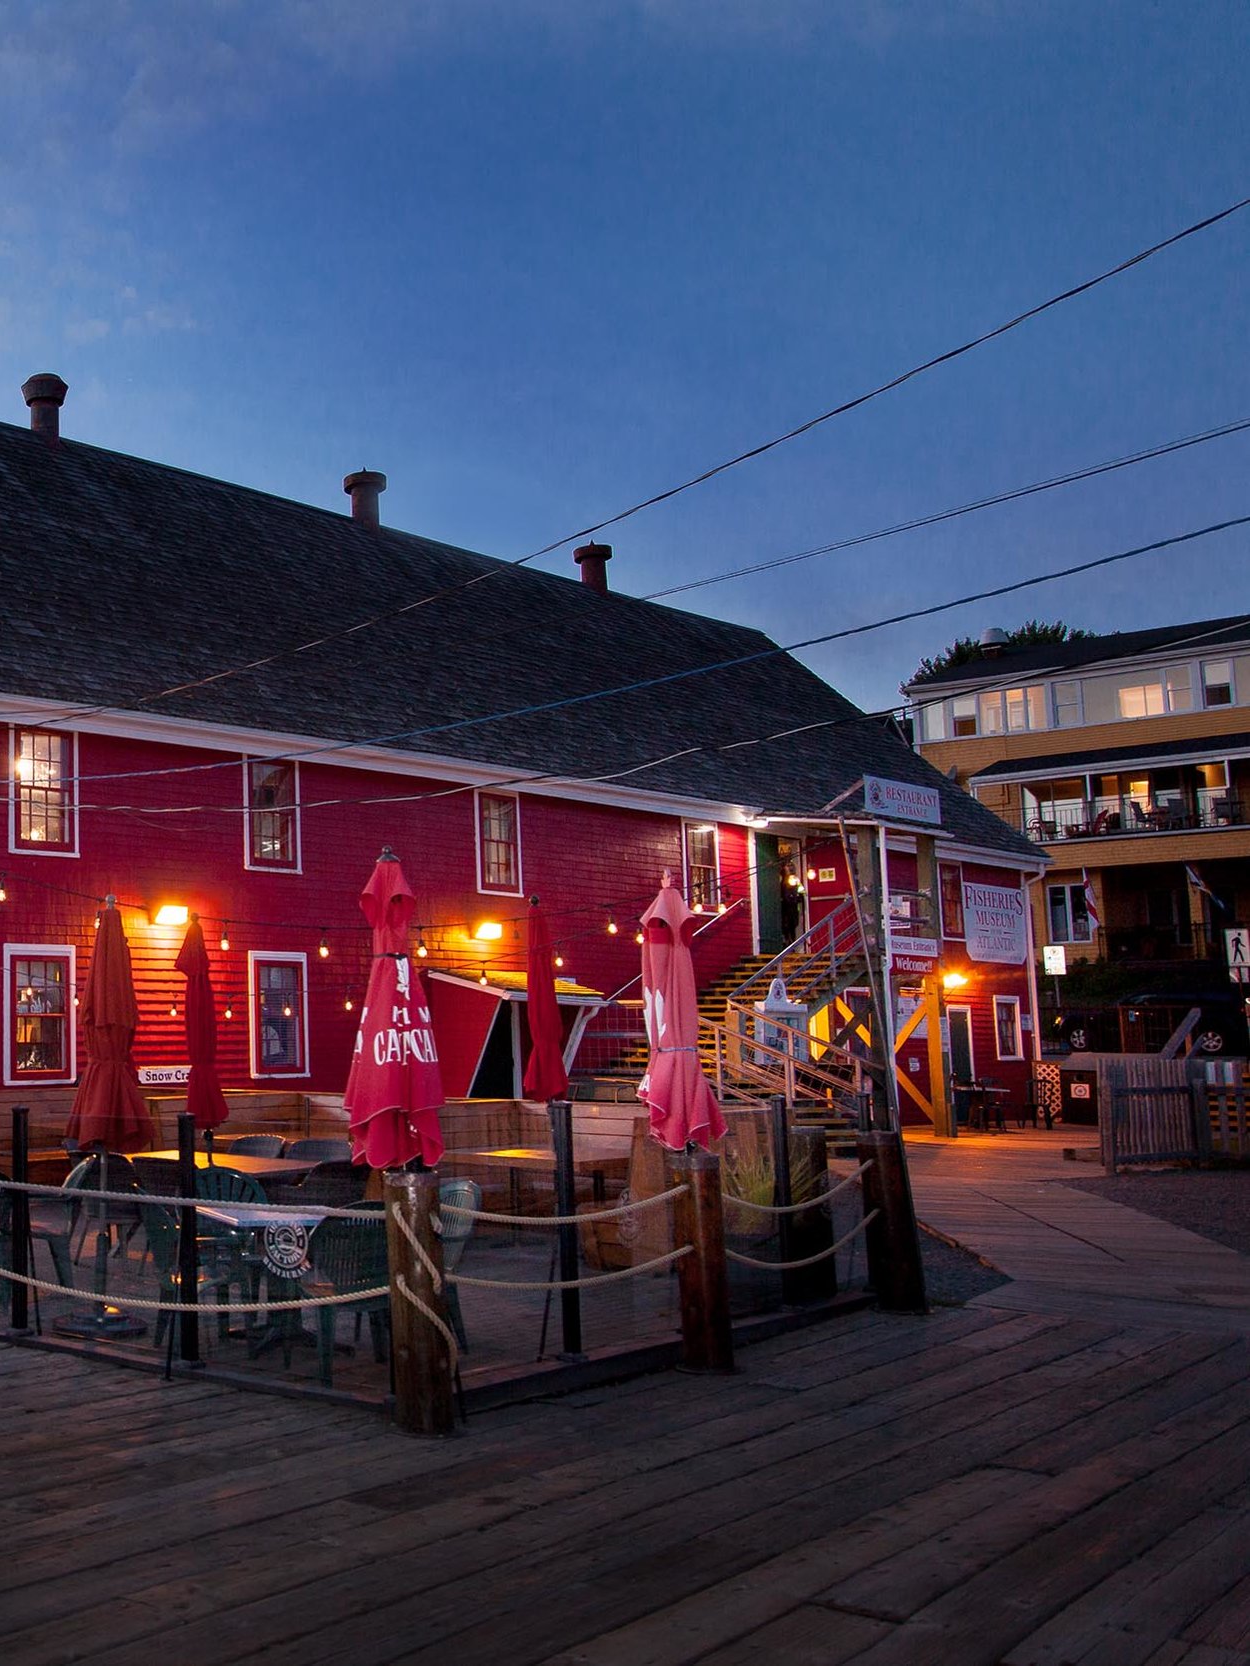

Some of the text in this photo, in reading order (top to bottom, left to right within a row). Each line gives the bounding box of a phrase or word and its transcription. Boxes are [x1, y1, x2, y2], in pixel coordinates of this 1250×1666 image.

[963, 885, 1024, 916] FISHERIES
[976, 910, 1016, 929] MUSEUM
[977, 935, 1016, 952] ATLANTIC
[145, 1071, 173, 1081] Snow
